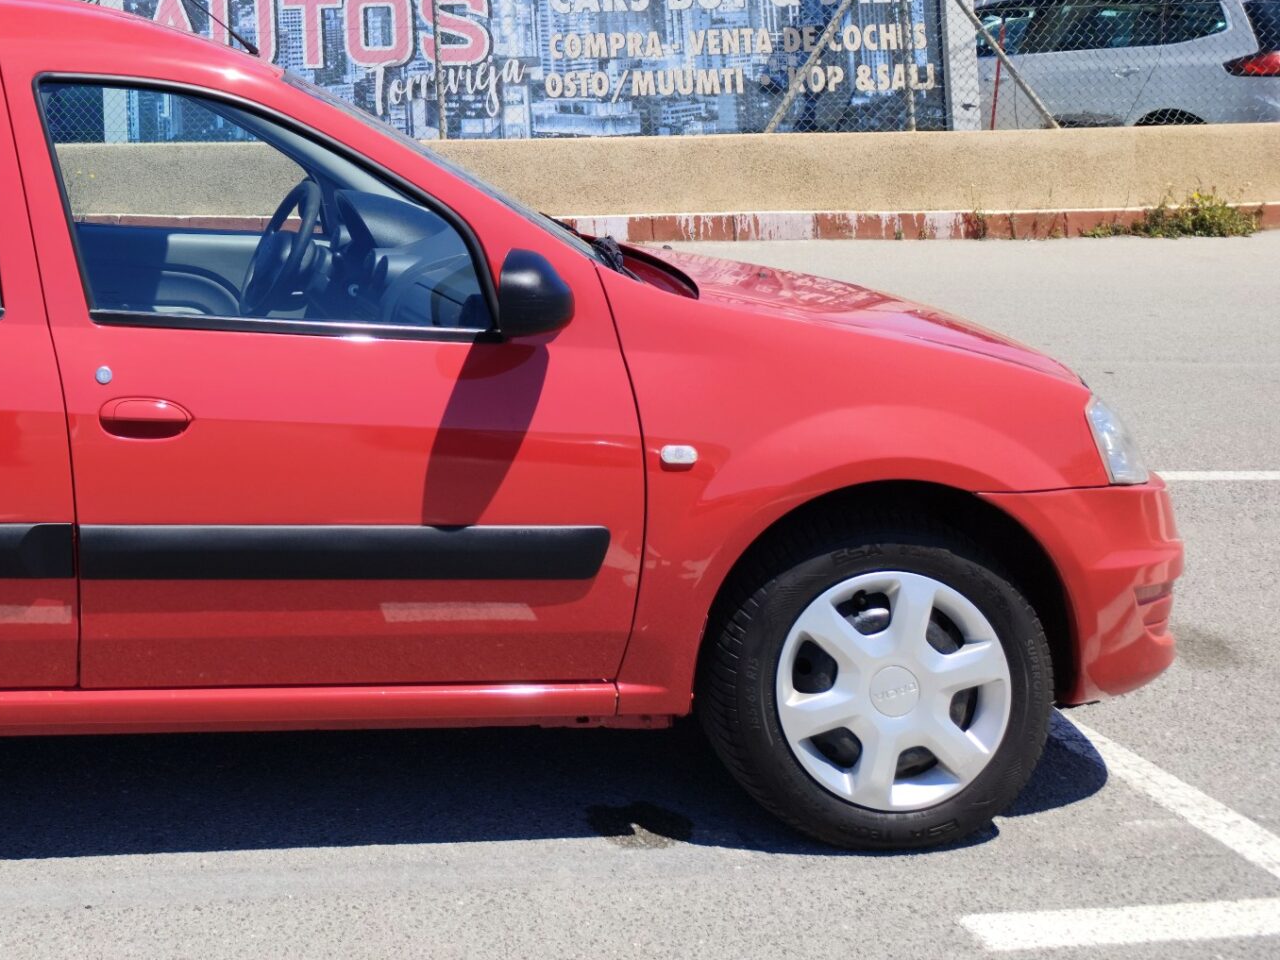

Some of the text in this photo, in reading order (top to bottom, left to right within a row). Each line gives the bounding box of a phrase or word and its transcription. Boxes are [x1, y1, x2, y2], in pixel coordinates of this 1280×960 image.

[551, 31, 660, 61] COMPRA
[689, 26, 774, 57] VENTA
[783, 26, 819, 53] DE
[363, 54, 527, 117] Torrevieja
[545, 68, 744, 103] OSTO/MUUMTI
